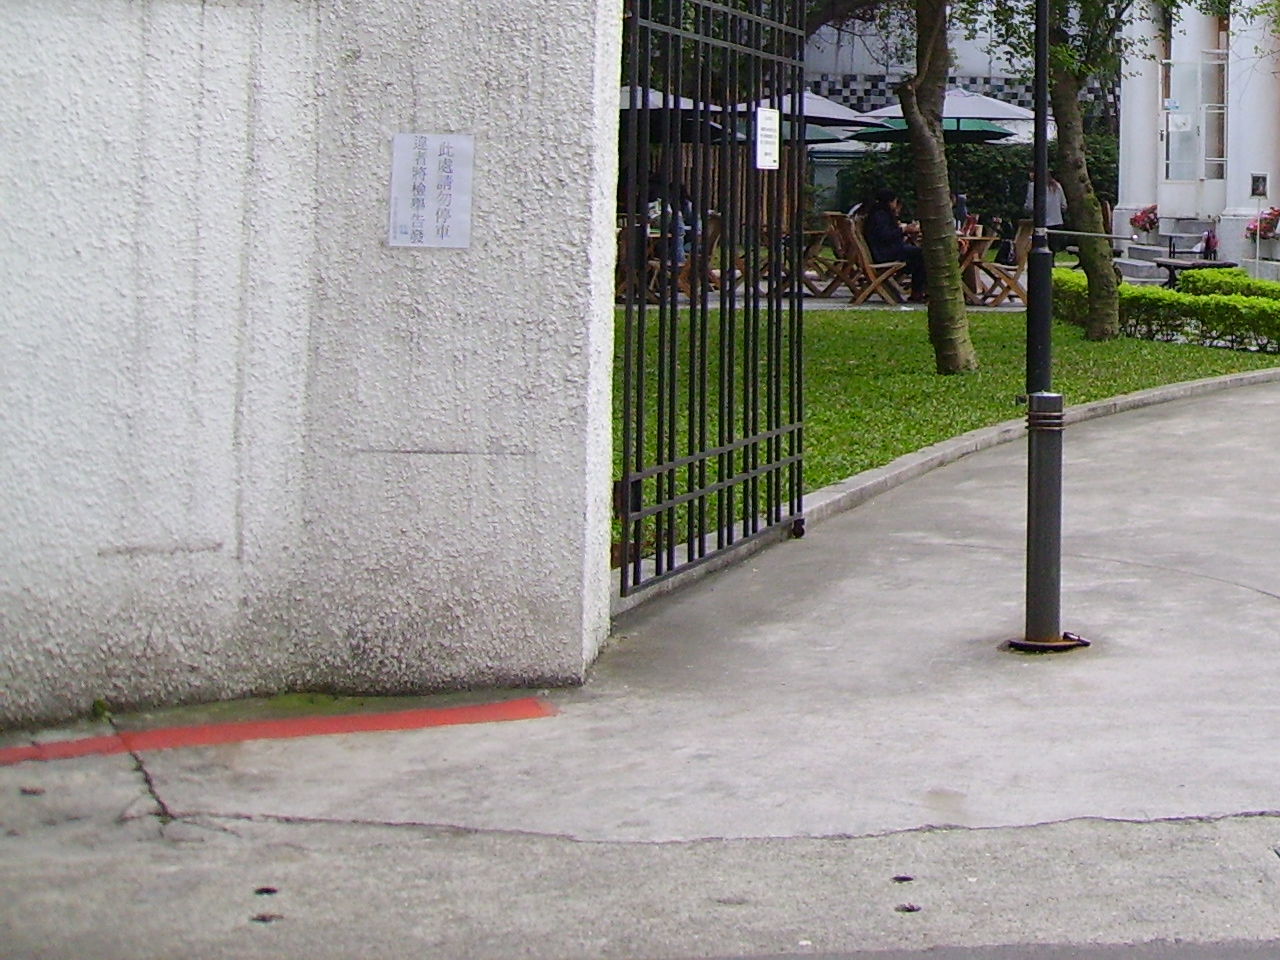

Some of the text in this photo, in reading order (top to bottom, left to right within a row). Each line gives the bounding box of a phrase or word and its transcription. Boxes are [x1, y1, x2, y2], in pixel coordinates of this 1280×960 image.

[435, 140, 455, 241] 此處請勿停車
